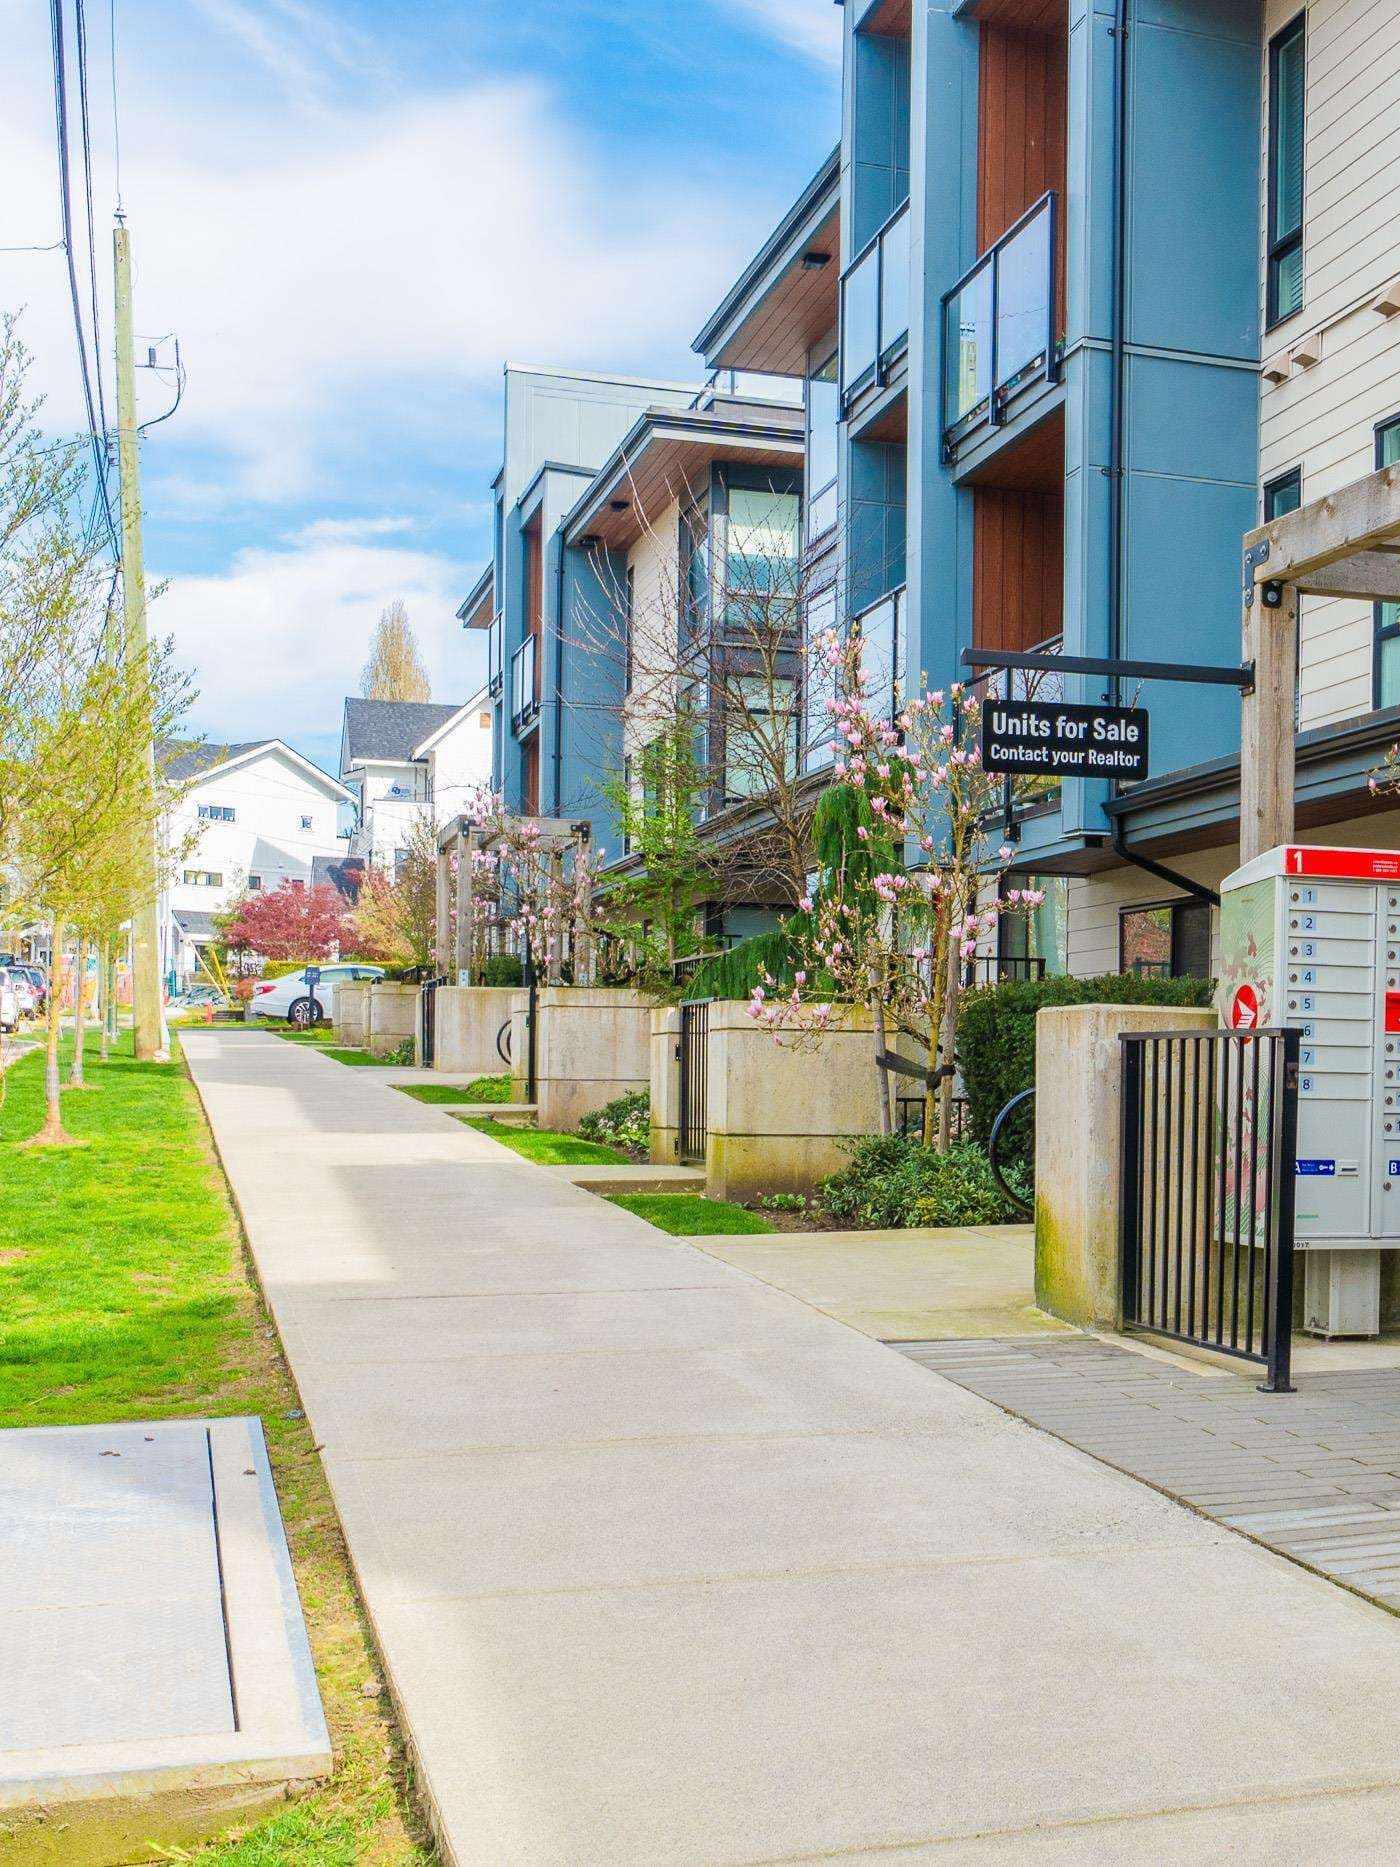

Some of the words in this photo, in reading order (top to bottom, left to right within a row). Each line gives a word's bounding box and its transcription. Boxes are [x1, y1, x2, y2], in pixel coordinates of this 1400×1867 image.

[993, 712, 1050, 737] Units
[1056, 716, 1087, 738] for
[1093, 718, 1139, 742] Sale
[991, 744, 1048, 762] Contact
[1052, 750, 1085, 766] your
[1089, 749, 1140, 767] Realtor
[1293, 851, 1303, 873] 1
[1307, 891, 1312, 901] 1
[1306, 918, 1313, 928] 2
[1306, 945, 1313, 955] 3
[1304, 972, 1312, 982] 4
[1304, 998, 1311, 1009] 5
[1304, 1026, 1311, 1036] 6
[1303, 1052, 1310, 1063] 7
[1303, 1079, 1310, 1090] 8
[1390, 1162, 1398, 1174] B
